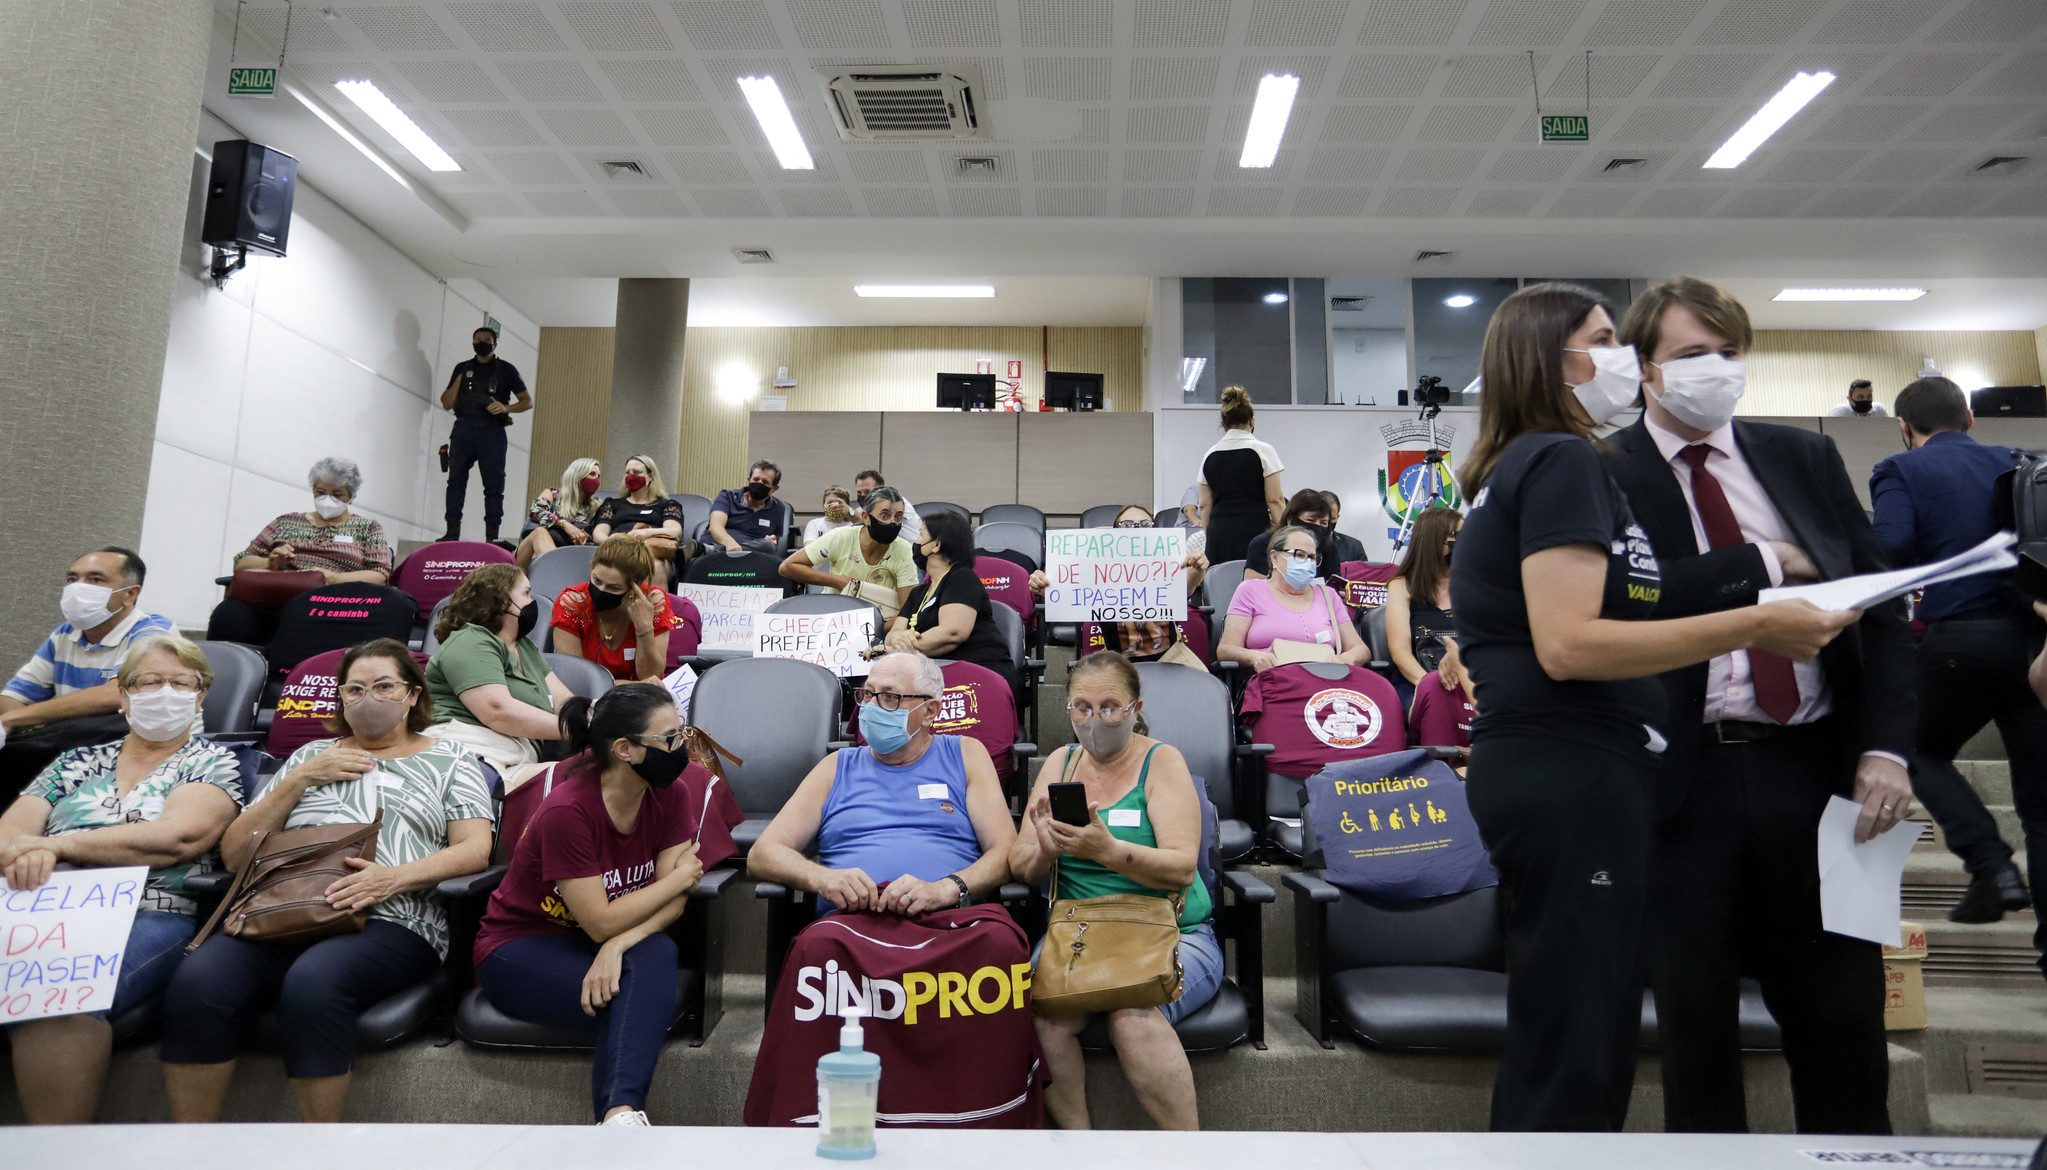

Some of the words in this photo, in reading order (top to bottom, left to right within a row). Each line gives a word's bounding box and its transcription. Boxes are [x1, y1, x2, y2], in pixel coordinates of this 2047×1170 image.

[1051, 533, 1181, 558] REPARCELAR
[1058, 563, 1079, 584] DE
[1095, 561, 1180, 585] NOVO?!?
[309, 595, 382, 604] SINDPROF/NH
[1049, 589, 1060, 603] O
[1071, 586, 1147, 607] IPASEM
[1155, 583, 1172, 606] É
[327, 610, 369, 618] caminho
[701, 612, 754, 627] PARCEL
[768, 612, 859, 634] CHEGA!!!
[1091, 607, 1173, 621] NOSSO!!!
[761, 631, 850, 652] PREFETA
[281, 685, 317, 697] EXIGE
[941, 692, 964, 700] AÇÃO
[942, 699, 965, 709] UER
[1334, 775, 1428, 795] Prioritário
[626, 859, 655, 884] LUTA
[0, 880, 137, 912] CELAR
[0, 922, 66, 957] DA
[0, 953, 119, 991] PASEM
[1883, 971, 1905, 983] APER
